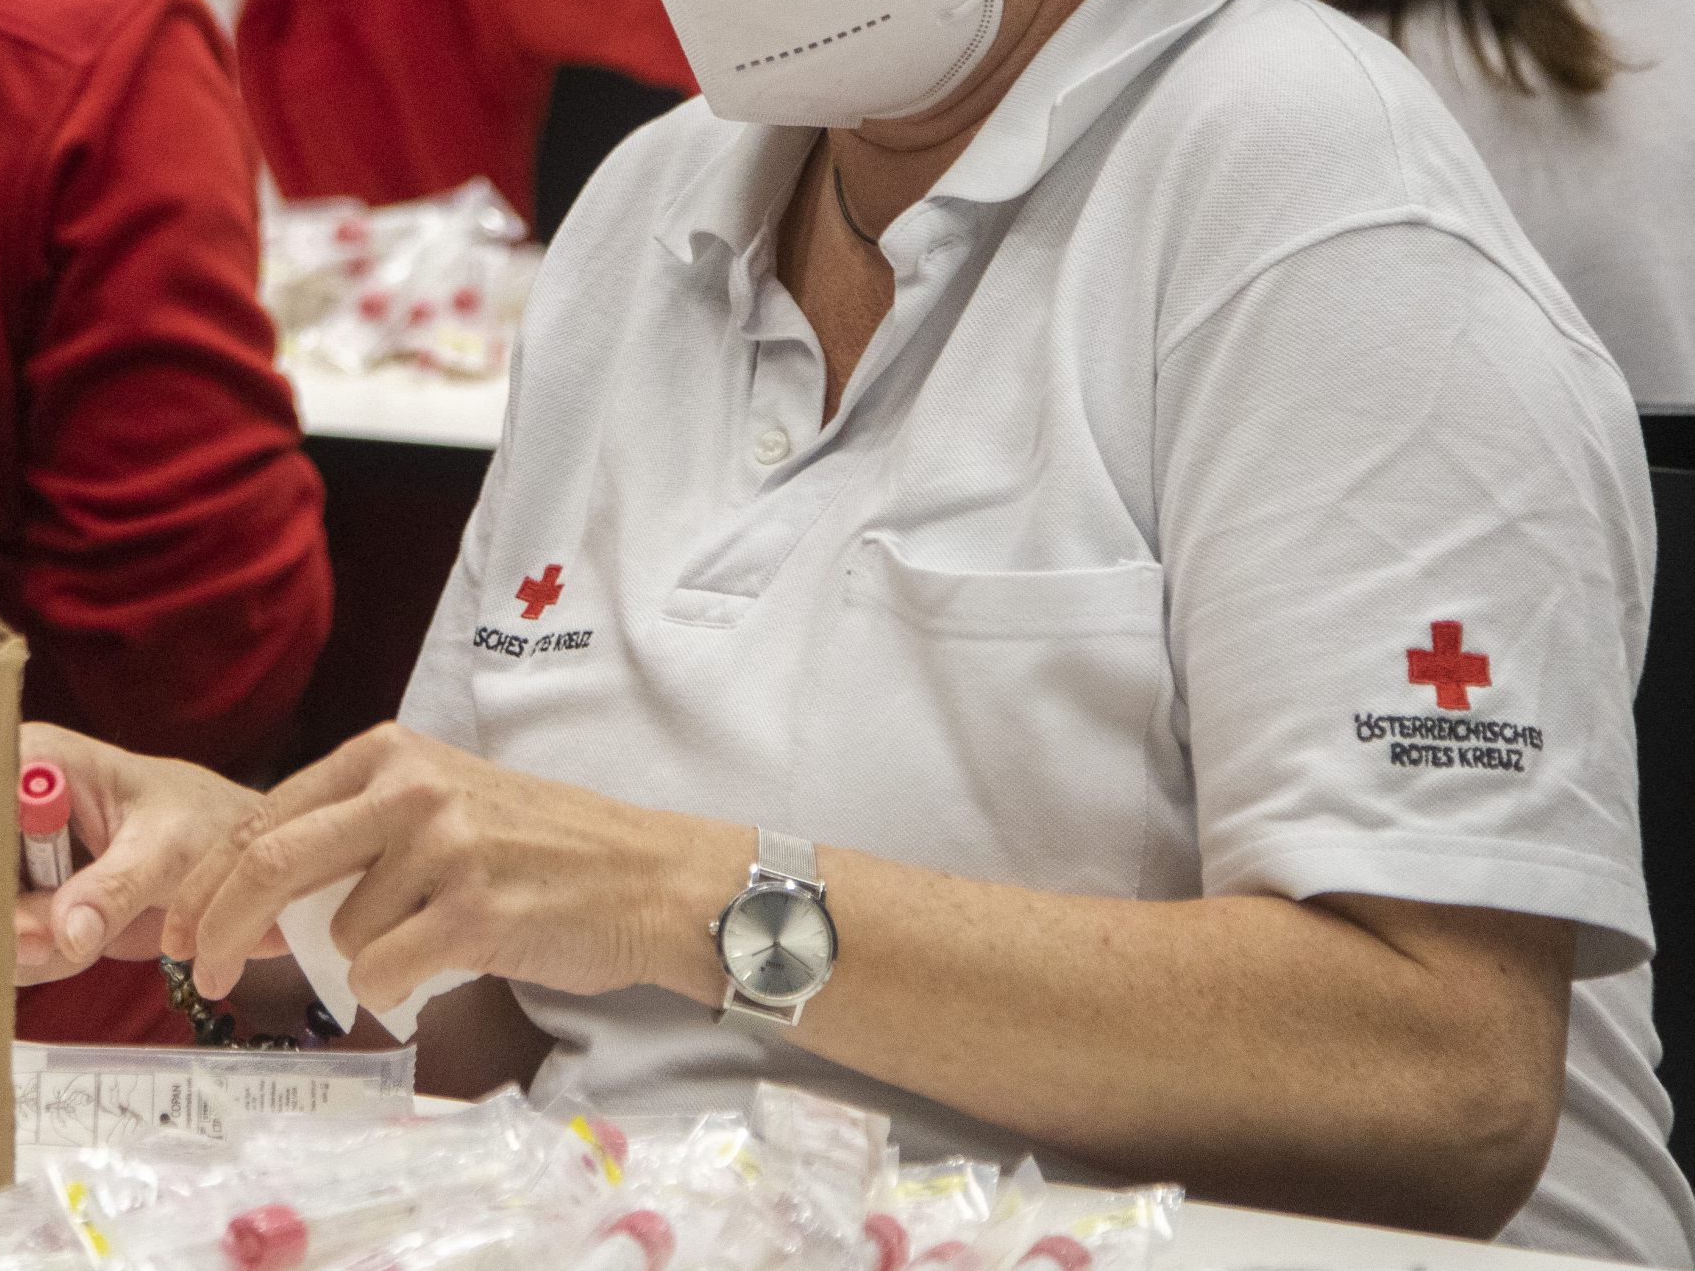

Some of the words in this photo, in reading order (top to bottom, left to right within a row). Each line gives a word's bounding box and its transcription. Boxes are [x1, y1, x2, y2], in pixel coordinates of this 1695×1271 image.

[1354, 712, 1544, 751] ÖSTERREICHISCHES
[1390, 742, 1455, 768] ROTES
[1457, 746, 1525, 773] KREUZ
